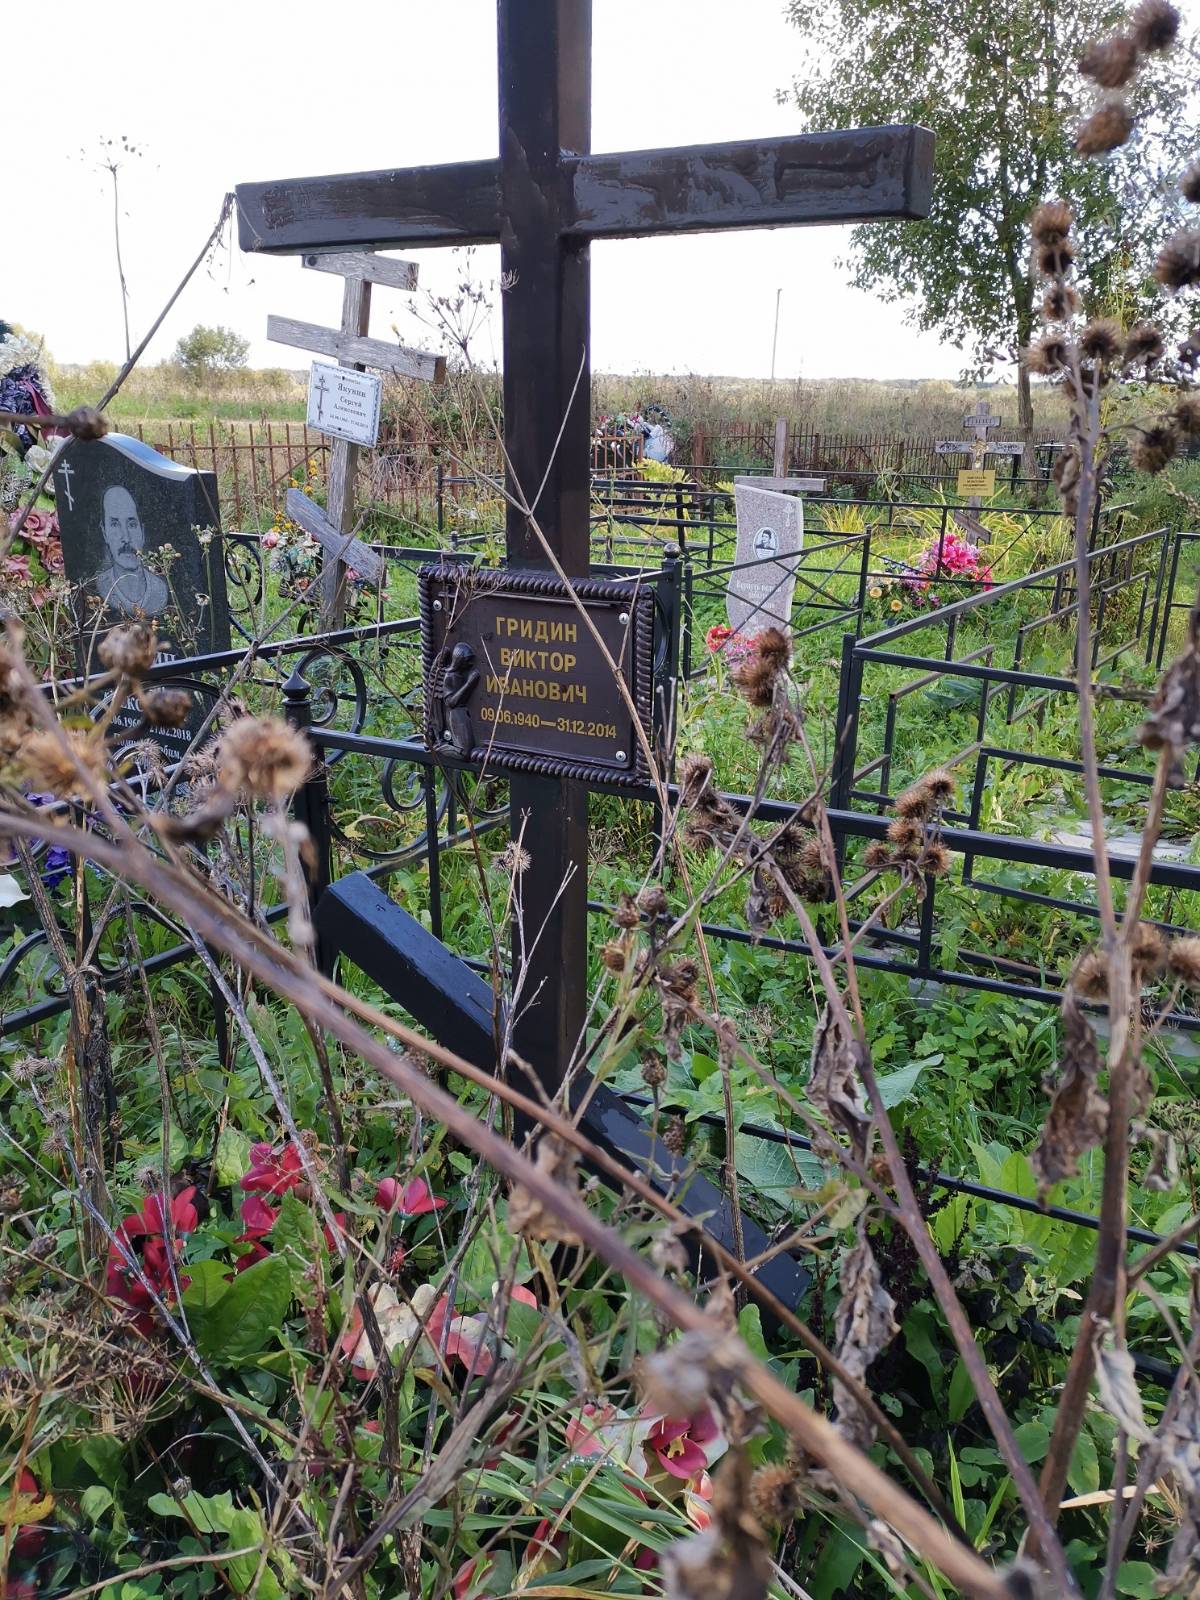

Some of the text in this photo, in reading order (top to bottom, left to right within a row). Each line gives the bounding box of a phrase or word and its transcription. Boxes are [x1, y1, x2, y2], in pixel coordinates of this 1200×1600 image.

[496, 616, 577, 643] ГРИДИН
[500, 647, 577, 673] ВИКТОР
[486, 675, 587, 704] ИВАНОВИЧ
